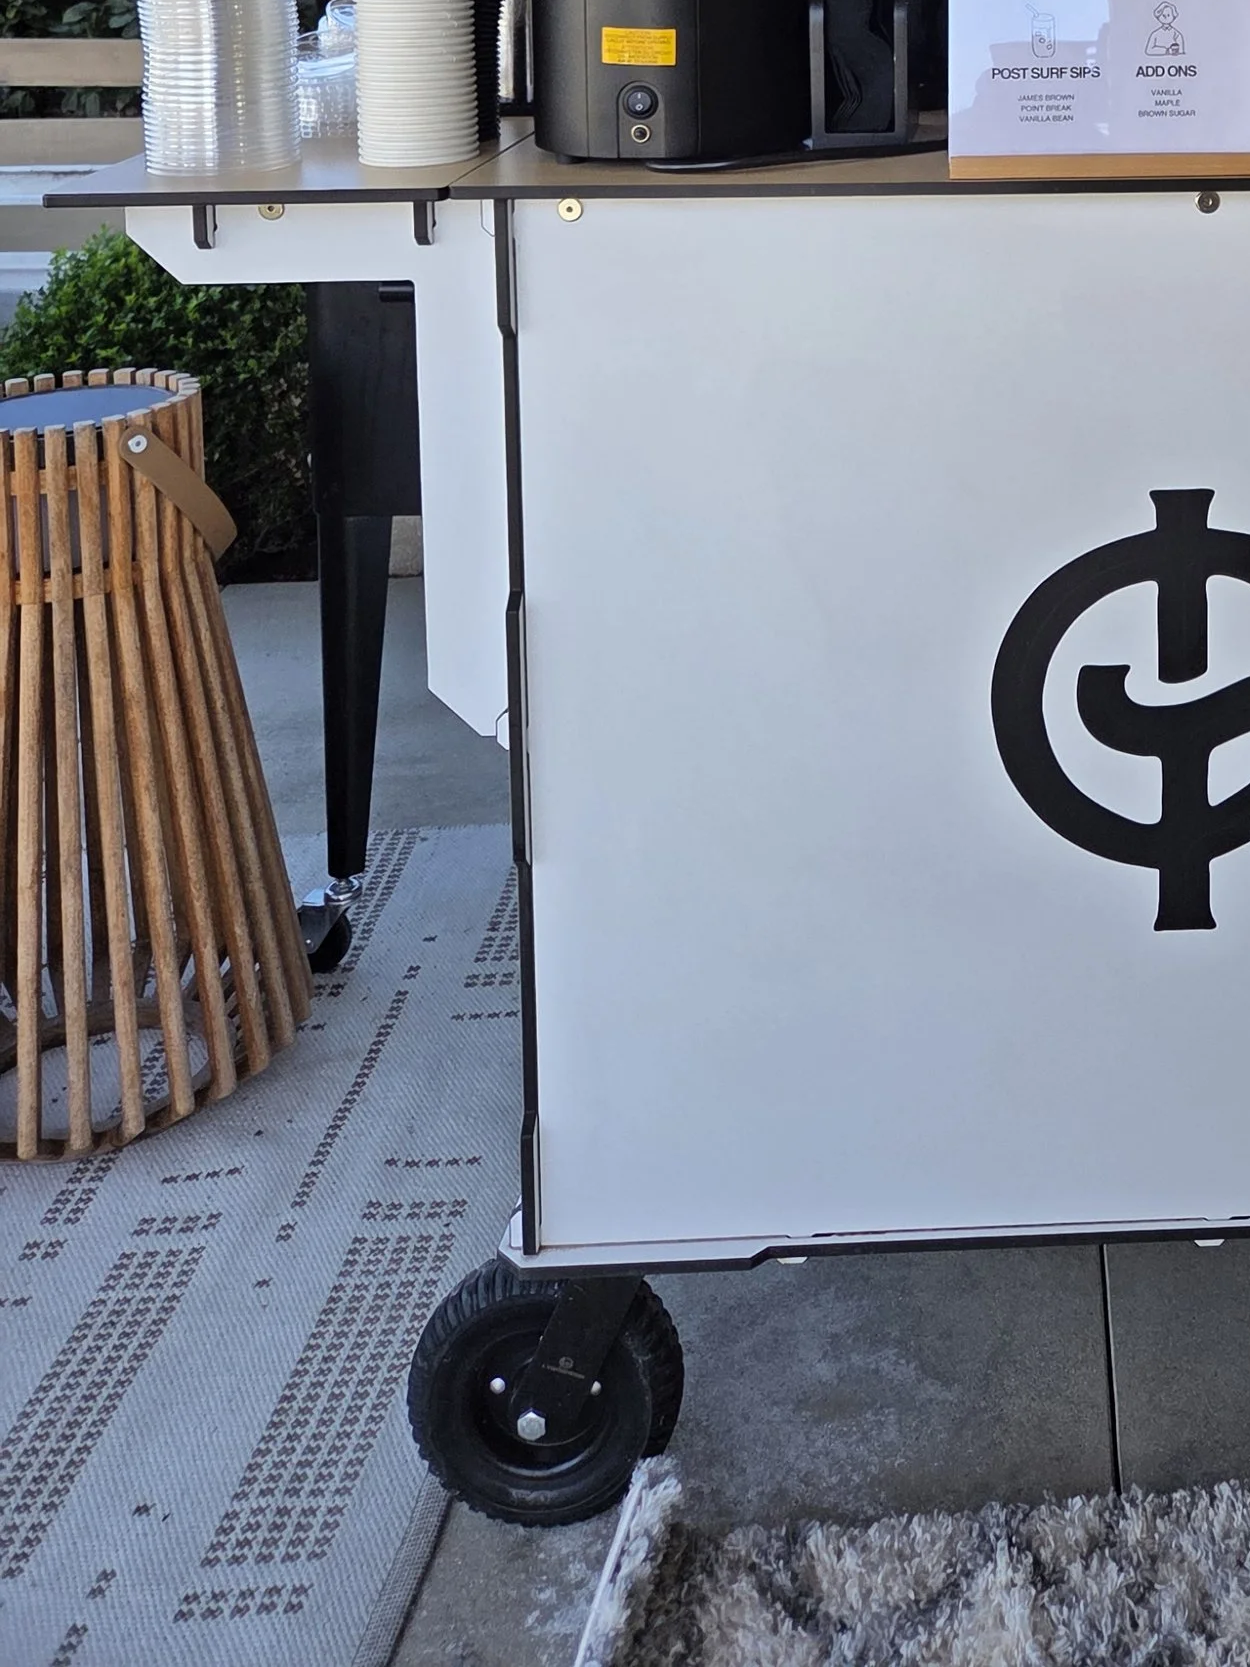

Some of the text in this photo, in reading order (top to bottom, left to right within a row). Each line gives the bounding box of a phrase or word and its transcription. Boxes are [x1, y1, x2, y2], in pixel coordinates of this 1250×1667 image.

[992, 66, 1101, 80] POST SURF SIPS
[1135, 65, 1198, 78] ADD ONS
[1018, 94, 1044, 102] JAMES
[1154, 99, 1181, 107] MAPLE
[1169, 109, 1196, 117] SUGAR
[1019, 115, 1051, 123] VANILLA
